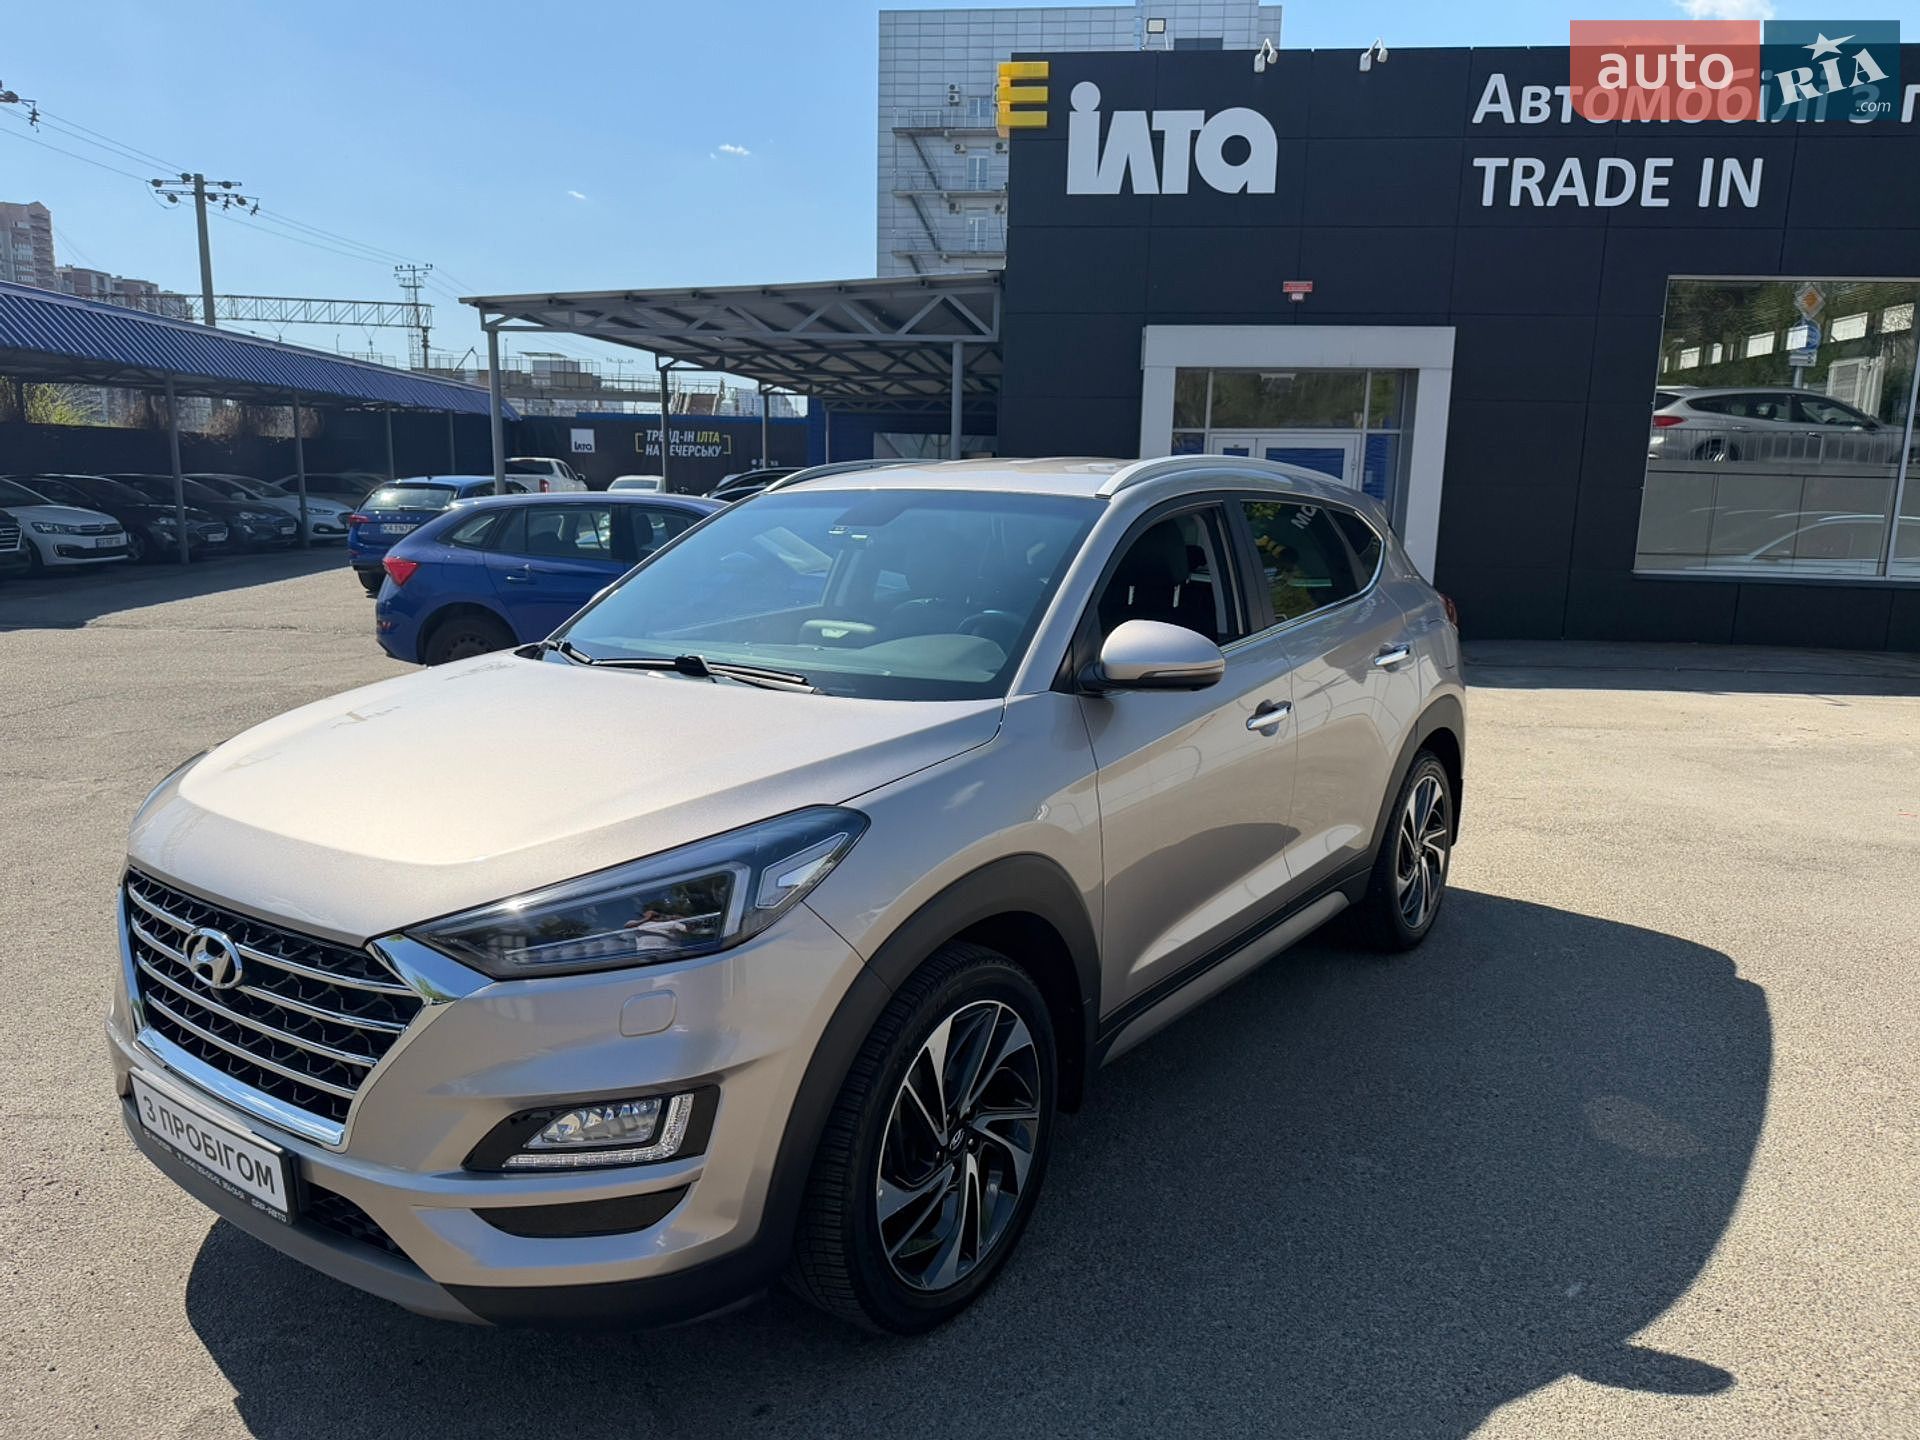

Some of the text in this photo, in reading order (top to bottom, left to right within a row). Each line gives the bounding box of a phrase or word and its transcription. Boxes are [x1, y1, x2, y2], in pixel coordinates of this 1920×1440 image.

[1472, 157, 1764, 208] TRADE IN
[645, 444, 660, 456] НА
[159, 1107, 276, 1195] ПРОБІГОМ
